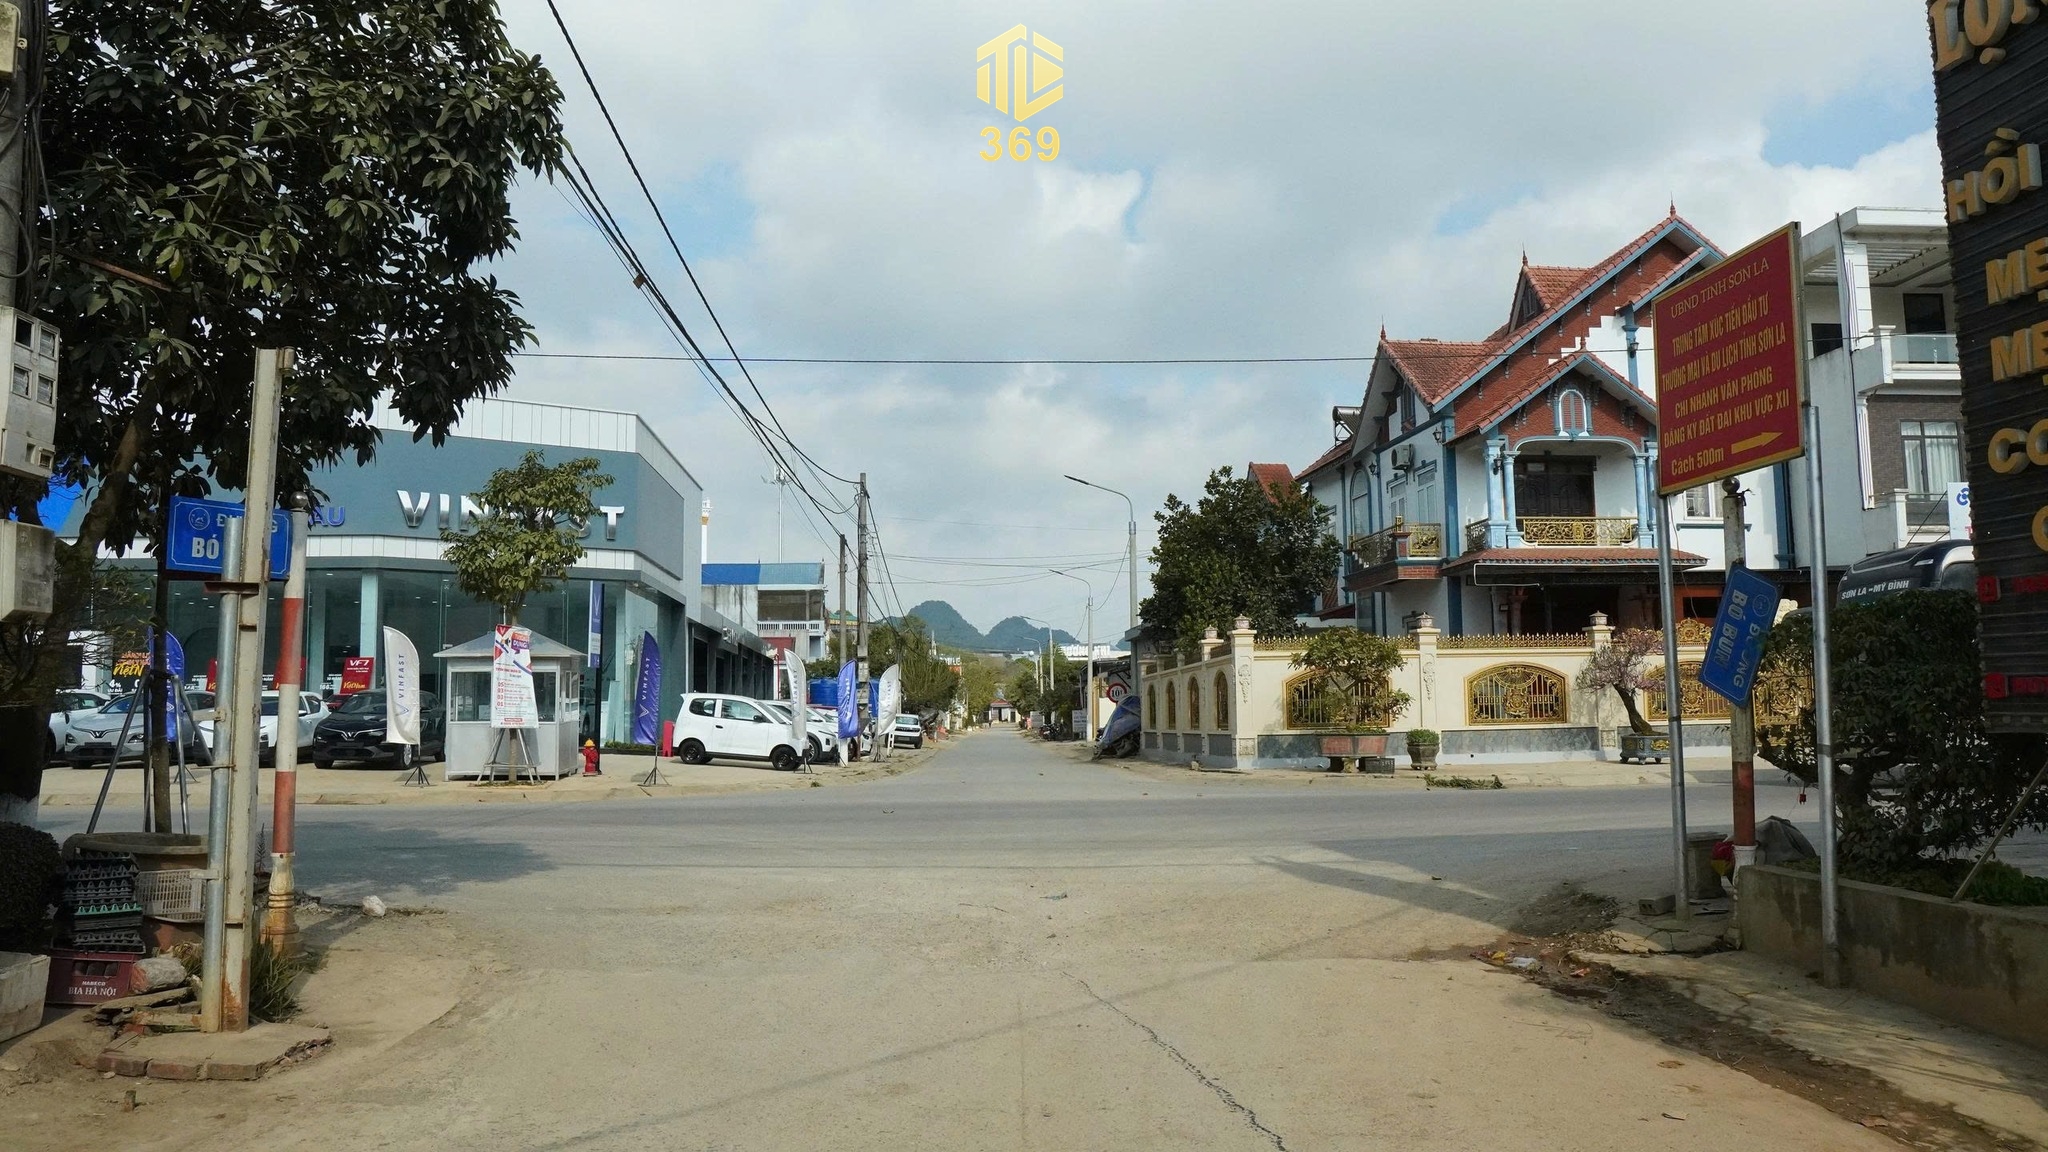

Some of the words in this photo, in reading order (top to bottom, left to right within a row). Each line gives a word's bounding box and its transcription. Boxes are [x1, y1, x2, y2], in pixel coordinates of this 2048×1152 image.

[1671, 295, 1699, 319] UBND
[1754, 257, 1769, 277] LA
[1672, 330, 1692, 357] TRUNG
[1687, 359, 1700, 384] MẠI
[1701, 351, 1710, 376] VÀ
[1711, 350, 1721, 372] DU
[1722, 342, 1738, 371] LỊCH
[1758, 327, 1774, 352] SƠN
[1776, 321, 1786, 345] LA
[1675, 400, 1688, 419] CHI
[1734, 402, 1753, 427] KHU
[1755, 394, 1773, 418] VỰC
[1776, 388, 1790, 410] XII
[1671, 455, 1695, 476] Cách
[1697, 447, 1724, 469] 500m
[191, 534, 219, 559] BÓ
[1727, 589, 1748, 620] BÓ
[1857, 586, 1867, 596] LA
[642, 657, 650, 701] VINFAST
[69, 986, 83, 995] BIA
[85, 986, 98, 995] HÀ
